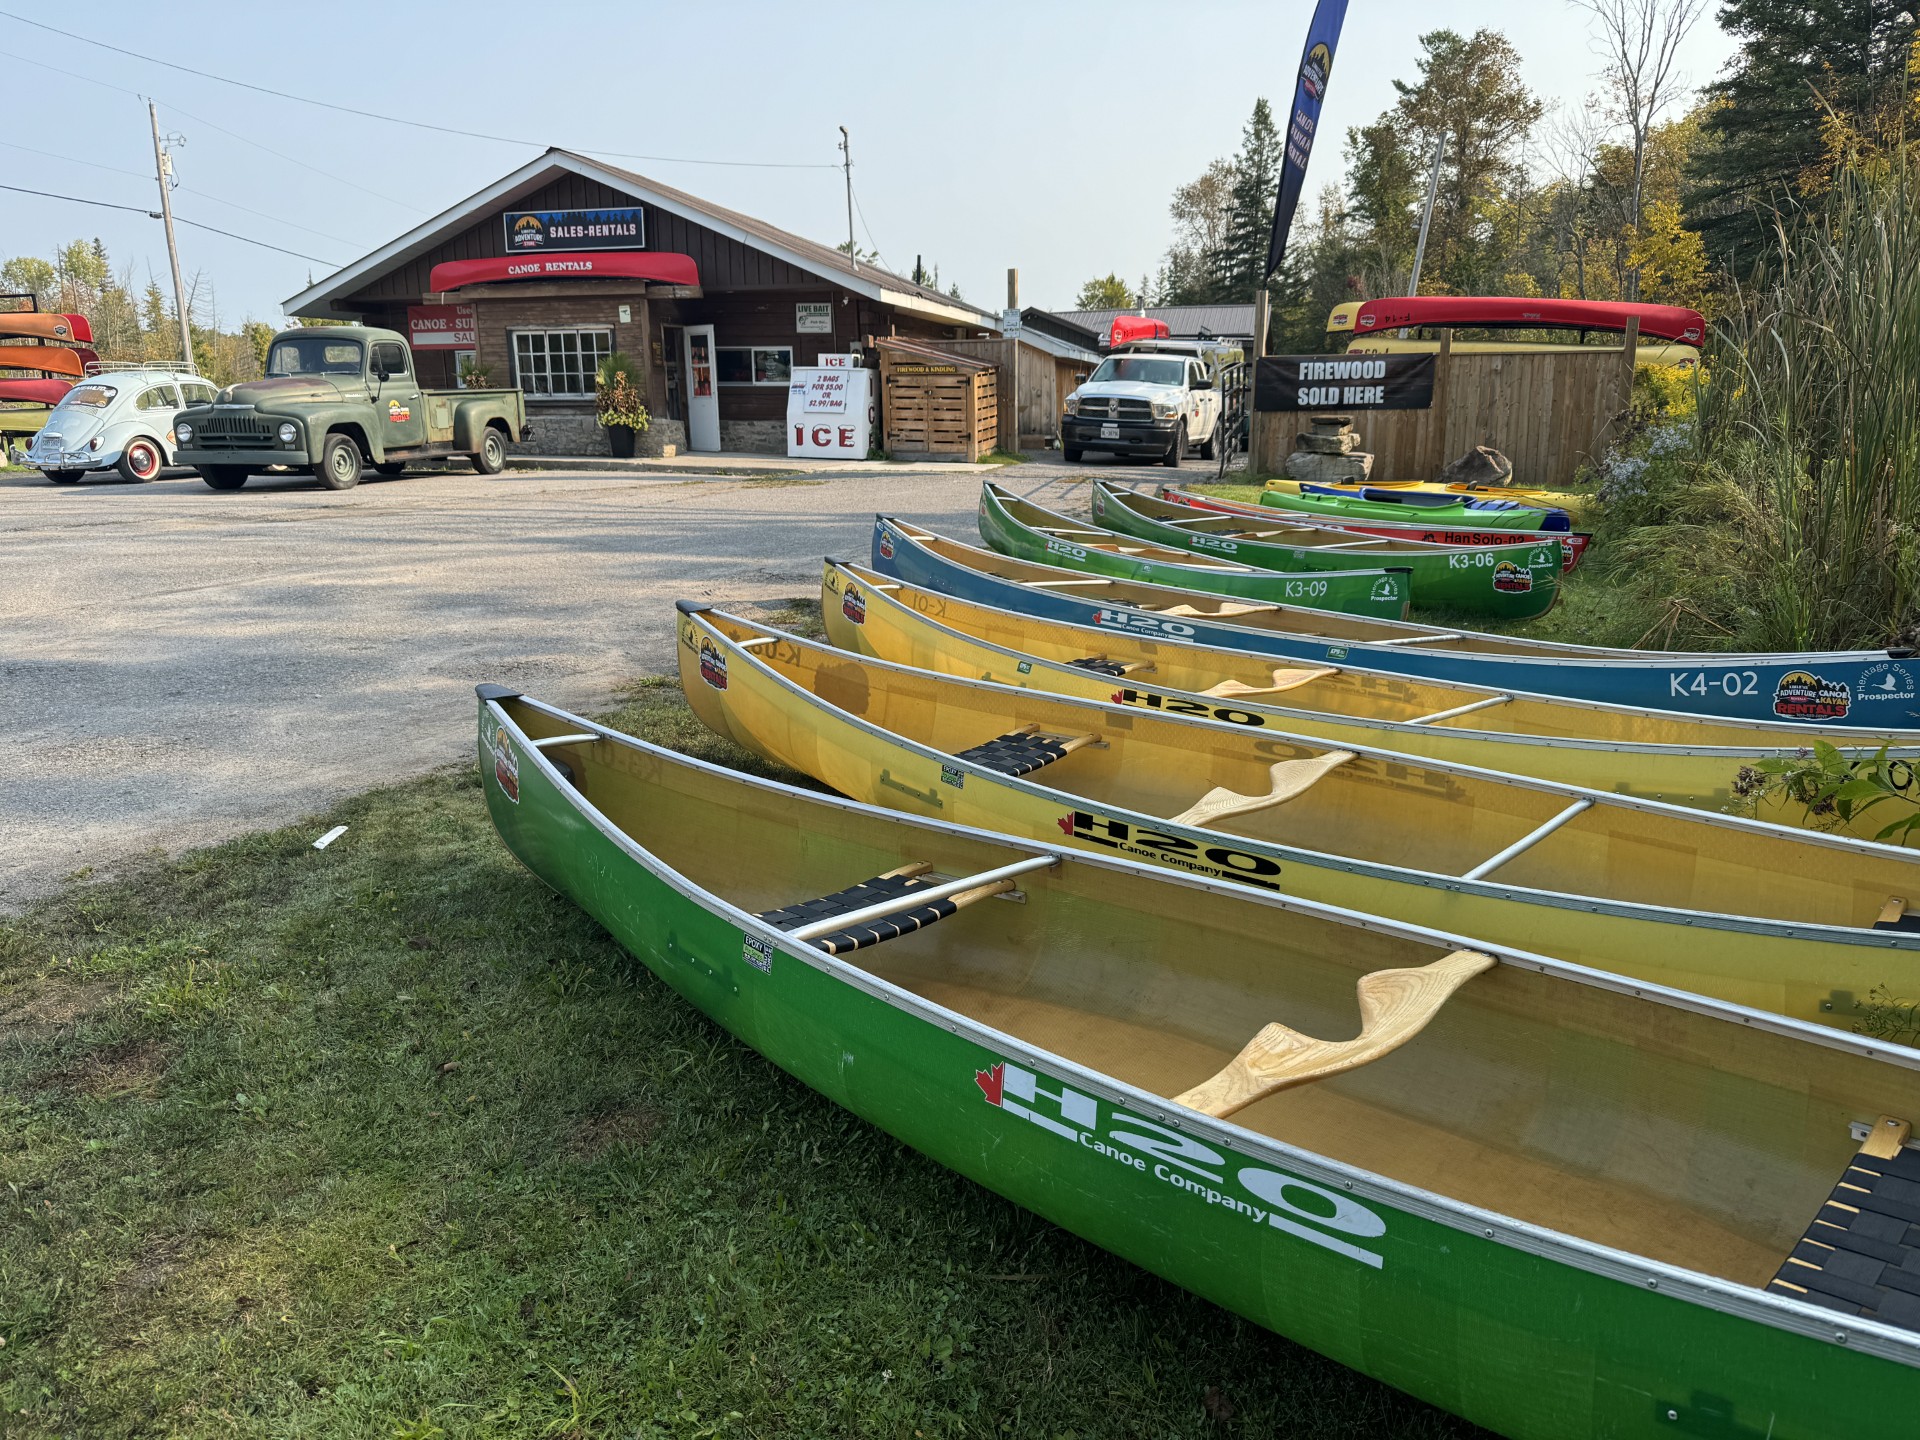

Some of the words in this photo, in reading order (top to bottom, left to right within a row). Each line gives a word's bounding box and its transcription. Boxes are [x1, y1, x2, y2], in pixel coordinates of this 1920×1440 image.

[1296, 109, 1314, 133] CANOE
[514, 233, 543, 242] ADVENTURE
[549, 224, 637, 238] SALES-RENTALS
[508, 264, 540, 275] CANOE
[545, 262, 593, 272] RENTALS
[411, 319, 447, 330] CANOE
[825, 358, 845, 366] ICE
[1299, 361, 1386, 380] FIREWOOD
[1297, 387, 1340, 406] SOLD
[1343, 386, 1384, 405] HERE
[794, 423, 856, 448] ICE
[1449, 553, 1494, 568] K3-06
[1285, 581, 1327, 597] K3-09
[1122, 624, 1139, 632] Canoe
[1141, 627, 1169, 638] Company
[1670, 671, 1758, 697] K4-02
[1857, 663, 1888, 692] Heritage
[1892, 663, 1914, 690] Series
[1780, 689, 1817, 698] ADVENTURE
[1819, 690, 1848, 698] CANOE
[1858, 692, 1915, 701] Prospector
[1776, 703, 1846, 717] RENTALS
[1119, 842, 1157, 860] Canoe
[1160, 853, 1221, 877] Company
[745, 935, 763, 951] EPOXY
[1079, 1131, 1145, 1172] Canoe
[1155, 1163, 1267, 1223] Company
